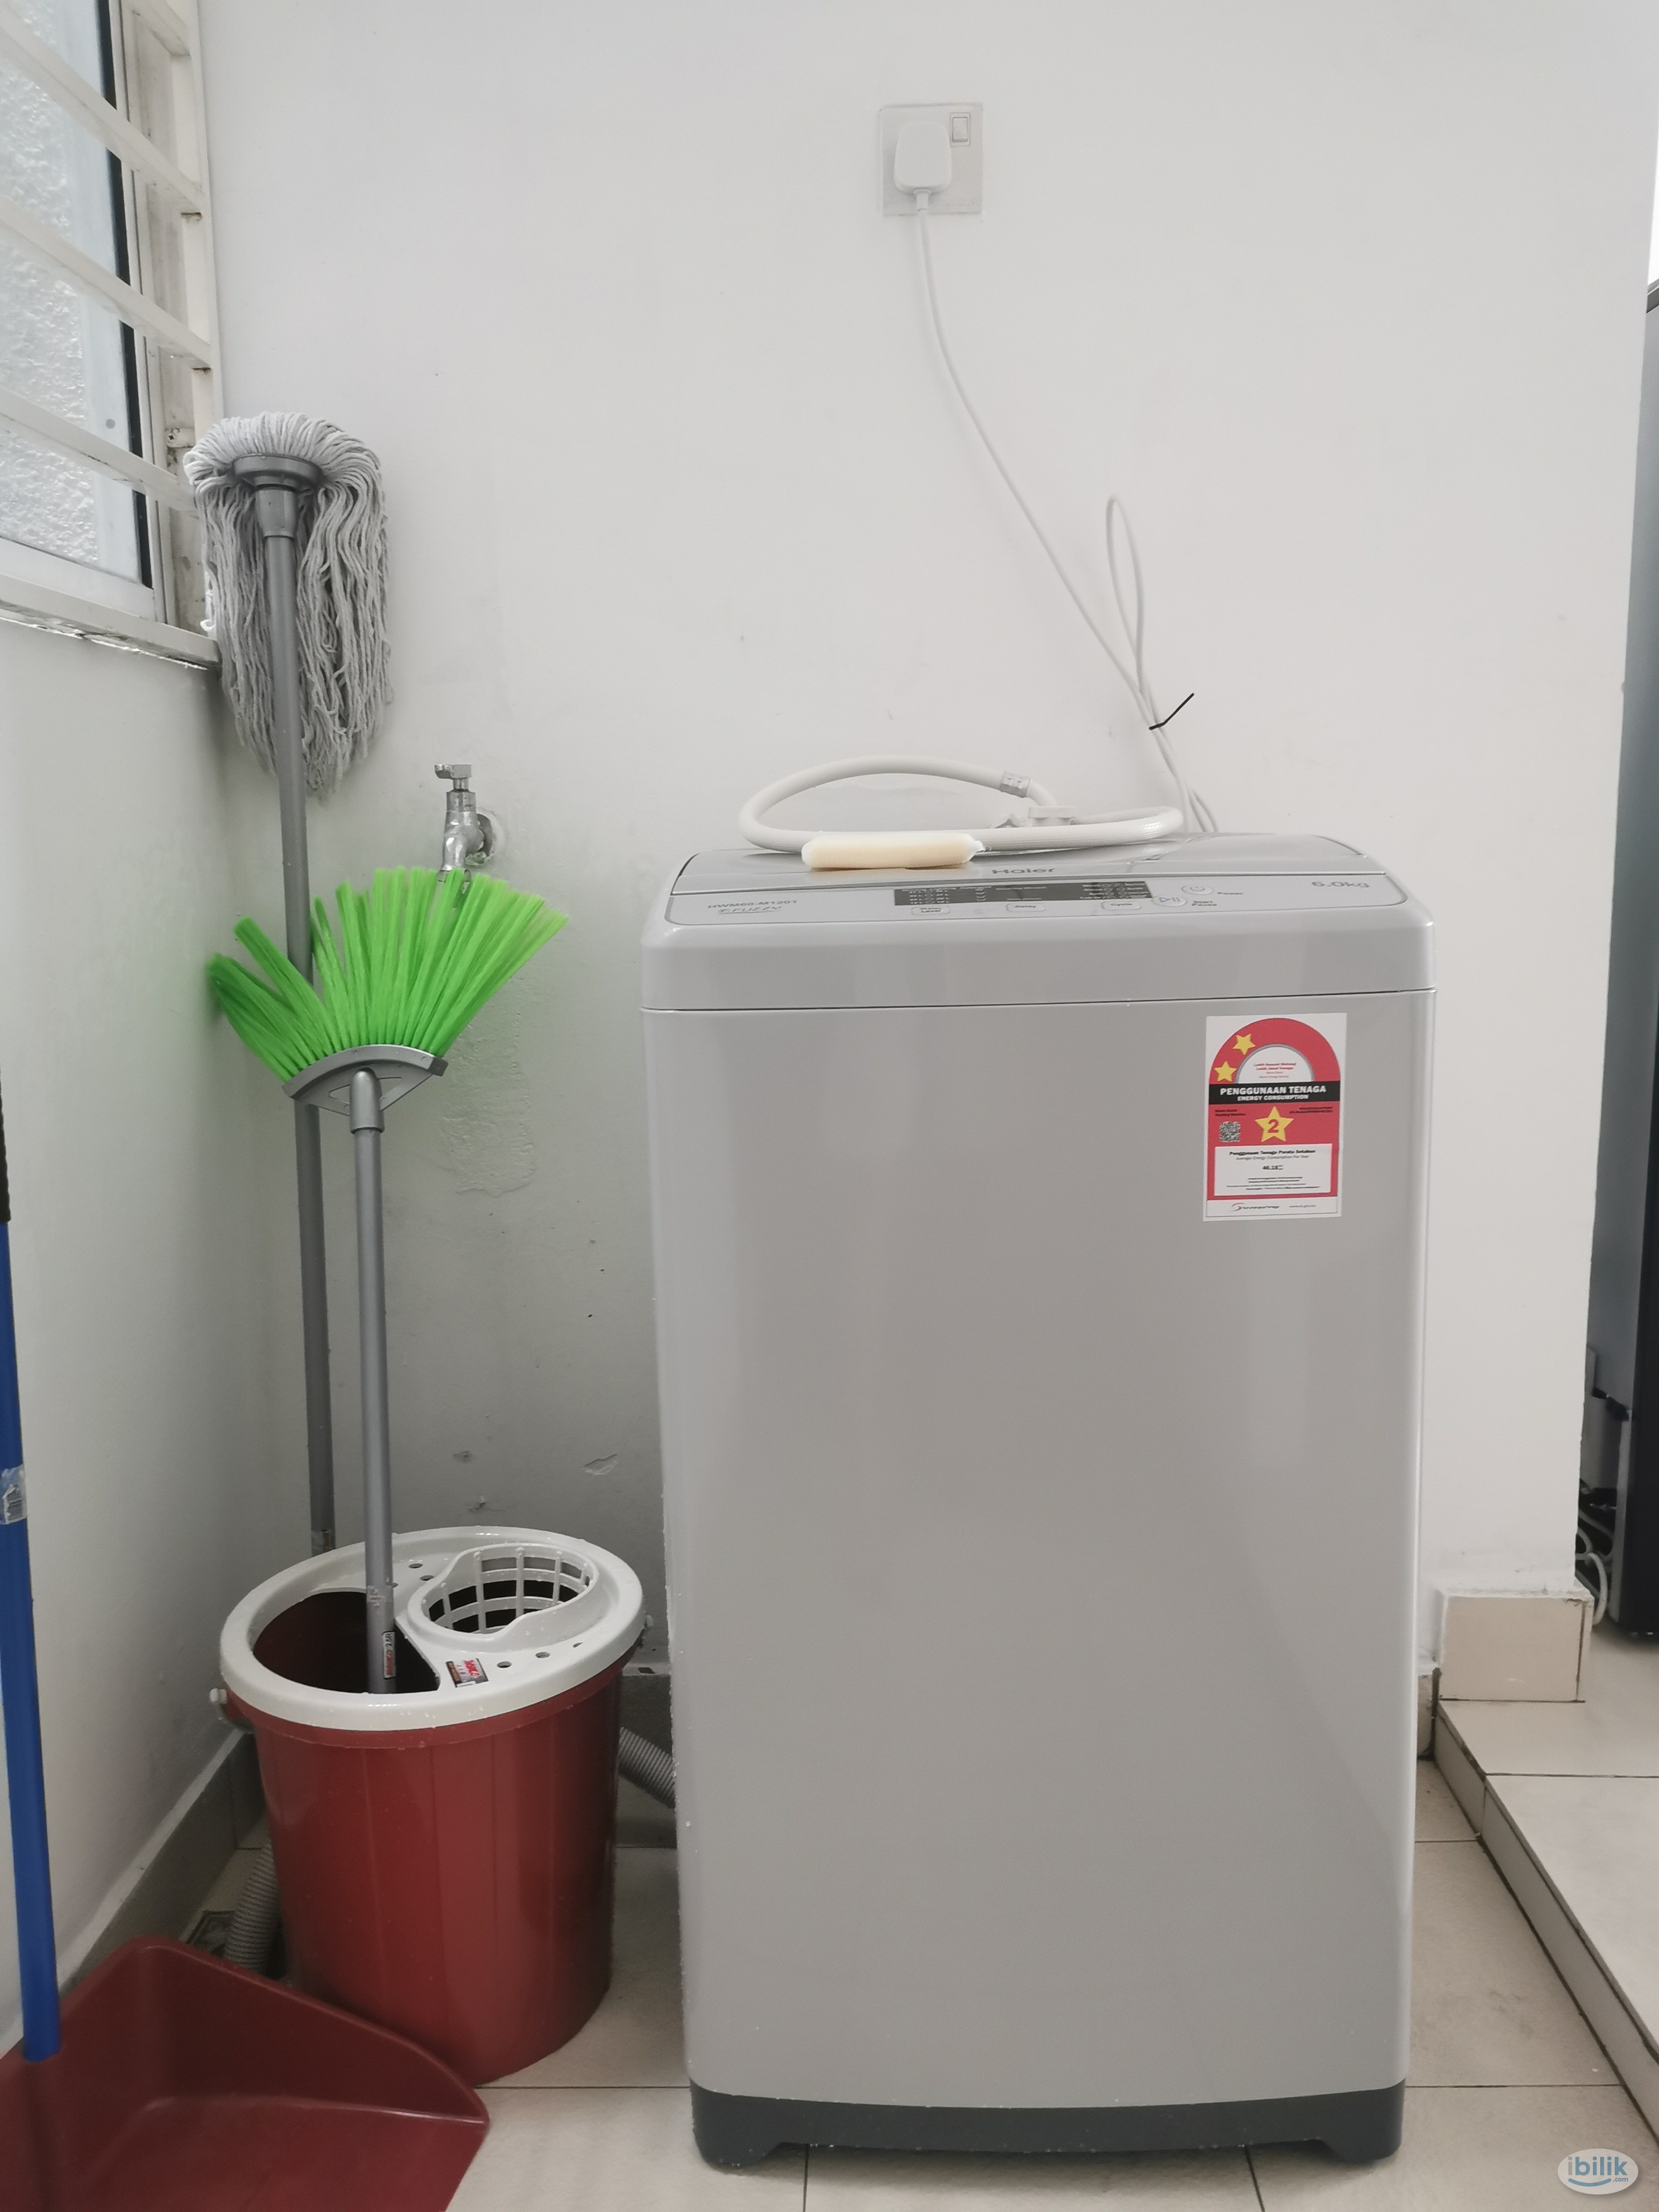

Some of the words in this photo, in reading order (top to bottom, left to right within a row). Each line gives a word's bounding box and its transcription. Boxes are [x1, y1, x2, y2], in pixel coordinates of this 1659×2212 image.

[1310, 880, 1371, 889] 6.0kg
[708, 900, 797, 908] HWM60-M1201
[1220, 1086, 1286, 1096] PENGGUNAAN
[1289, 1085, 1327, 1094] TENAGA
[1267, 1119, 1279, 1134] 2
